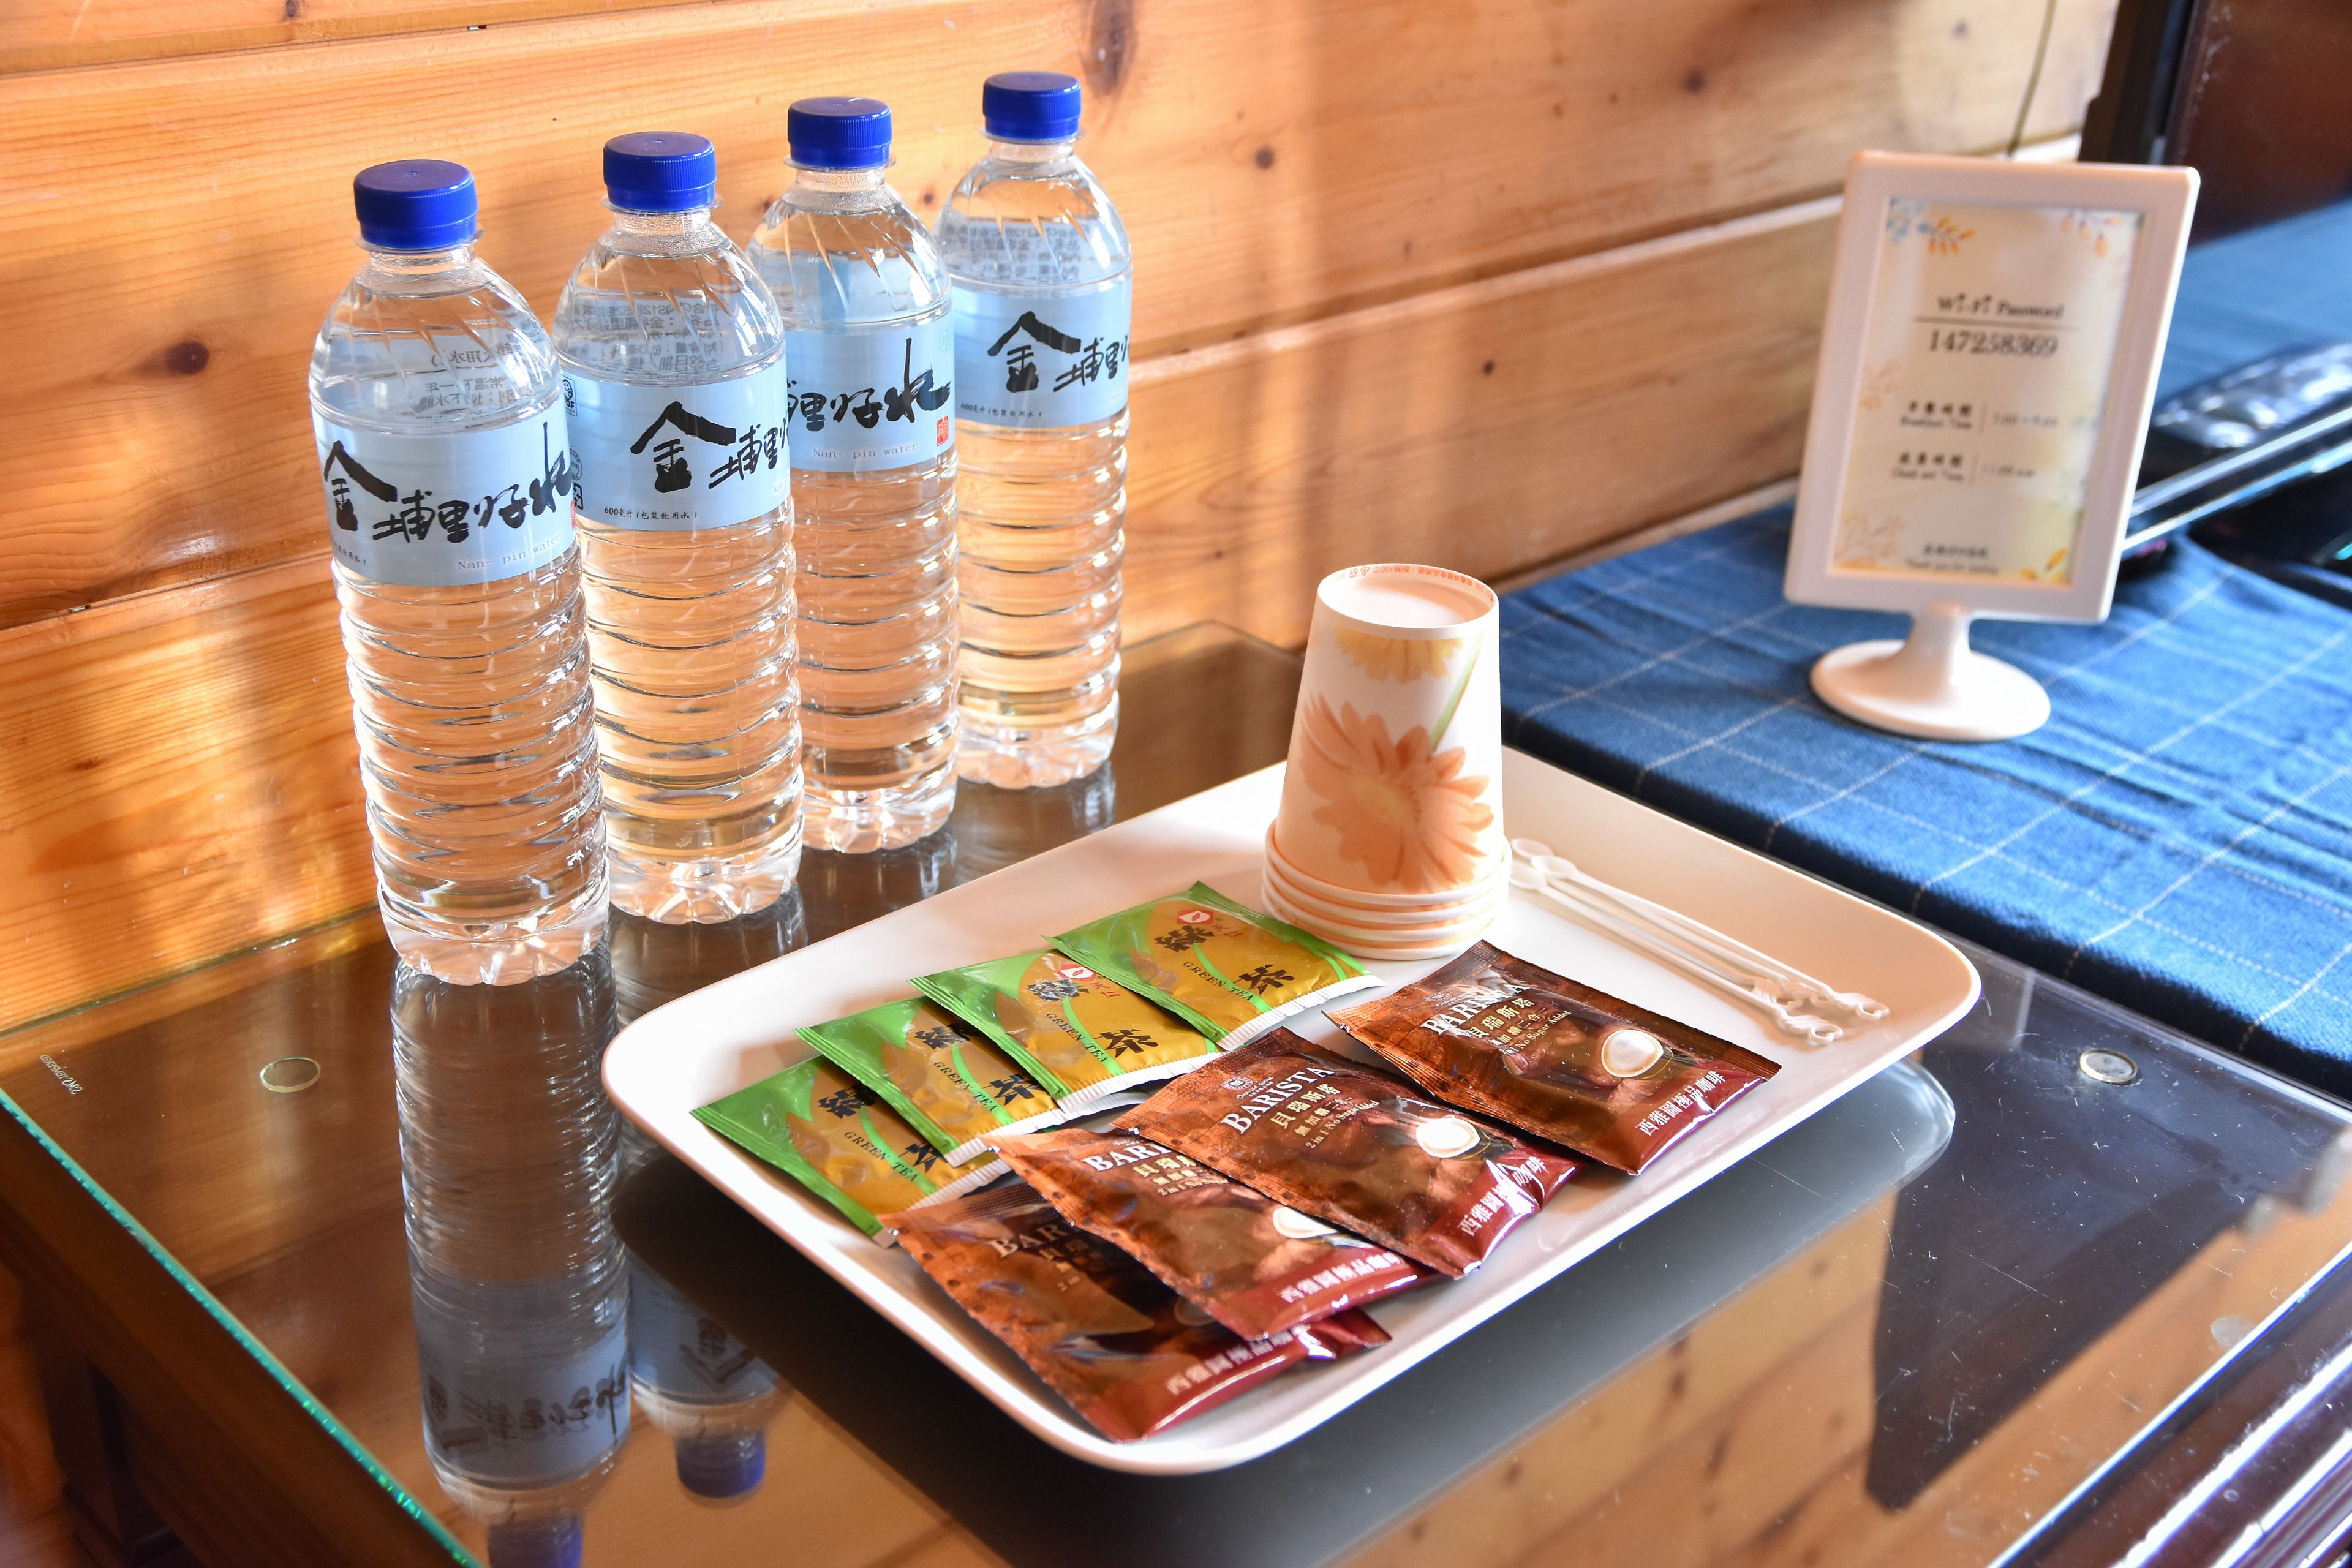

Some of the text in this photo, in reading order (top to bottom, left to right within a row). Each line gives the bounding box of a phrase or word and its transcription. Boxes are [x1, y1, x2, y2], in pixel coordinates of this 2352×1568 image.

[1997, 300, 2064, 320] Password
[1929, 329, 2058, 359] 147258369
[853, 449, 876, 459] pin
[884, 443, 918, 456] water
[502, 551, 526, 565] pin
[532, 533, 561, 553] water
[1183, 961, 1255, 1001] GREEN TEA
[1466, 997, 1536, 1038] 貝瑞斯塔
[1515, 1039, 1530, 1049] No
[1526, 1023, 1550, 1040] Sugar
[1548, 1010, 1572, 1025] Added
[1046, 1012, 1109, 1063] GREEN TEA
[933, 1061, 998, 1112] GREEN TEA
[1220, 1068, 1335, 1134] BARISTA
[1270, 1083, 1341, 1129] 貝瑞斯塔
[1635, 1071, 1725, 1136] 西雅圖極品咖啡
[1324, 1119, 1340, 1130] No
[1335, 1107, 1359, 1120] Sugar
[845, 1131, 919, 1182] GREEN TEA
[1082, 1142, 1172, 1171] BARI
[987, 1224, 1069, 1259] BAR
